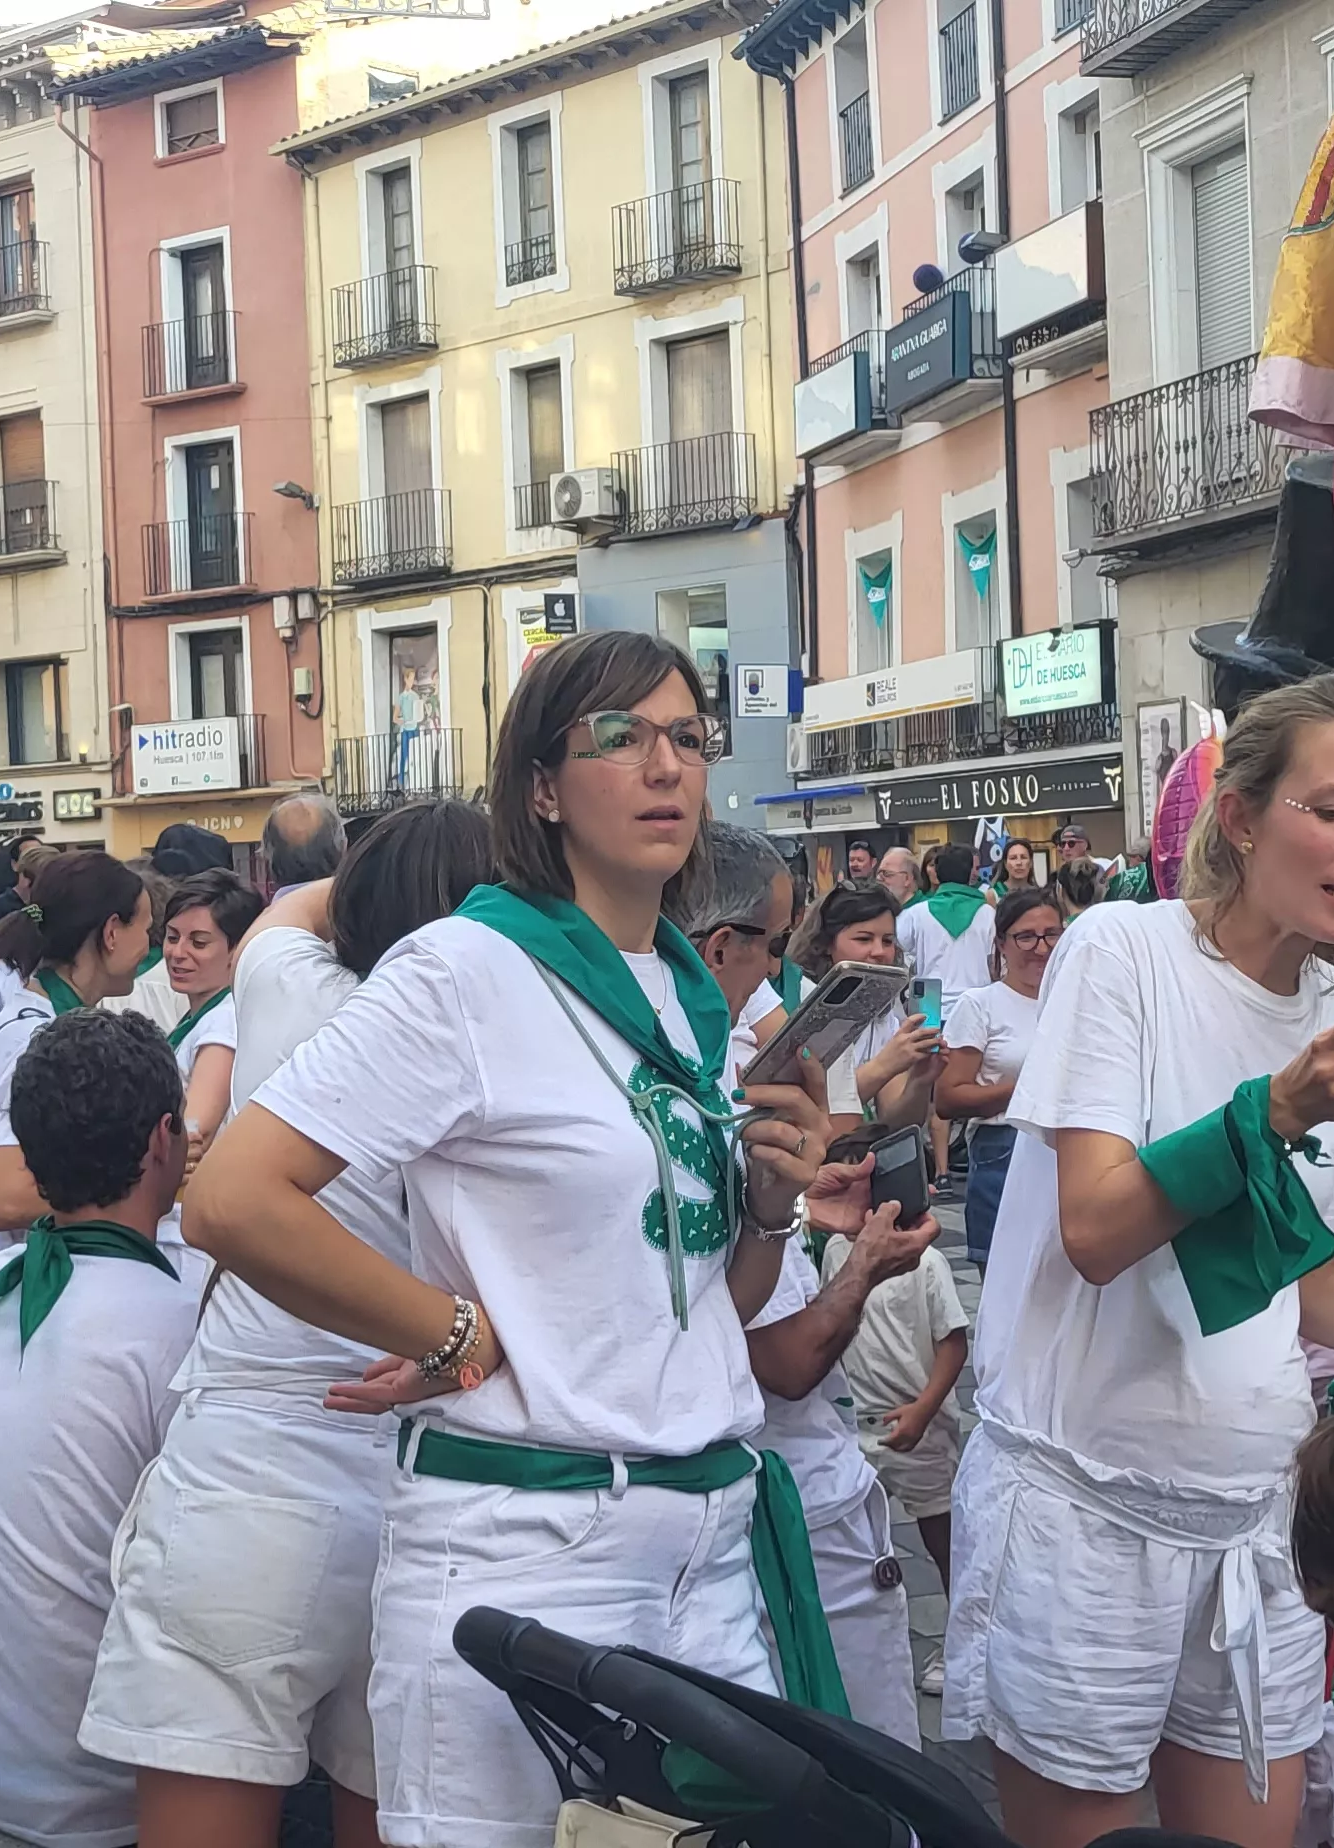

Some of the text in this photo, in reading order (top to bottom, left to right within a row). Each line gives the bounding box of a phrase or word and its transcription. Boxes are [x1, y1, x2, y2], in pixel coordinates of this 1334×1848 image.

[1037, 661, 1087, 685] DE HUESCA
[153, 725, 223, 750] hitradio
[154, 755, 184, 765] Huesca
[940, 783, 962, 810] EL
[971, 774, 1039, 808] FOSKO
